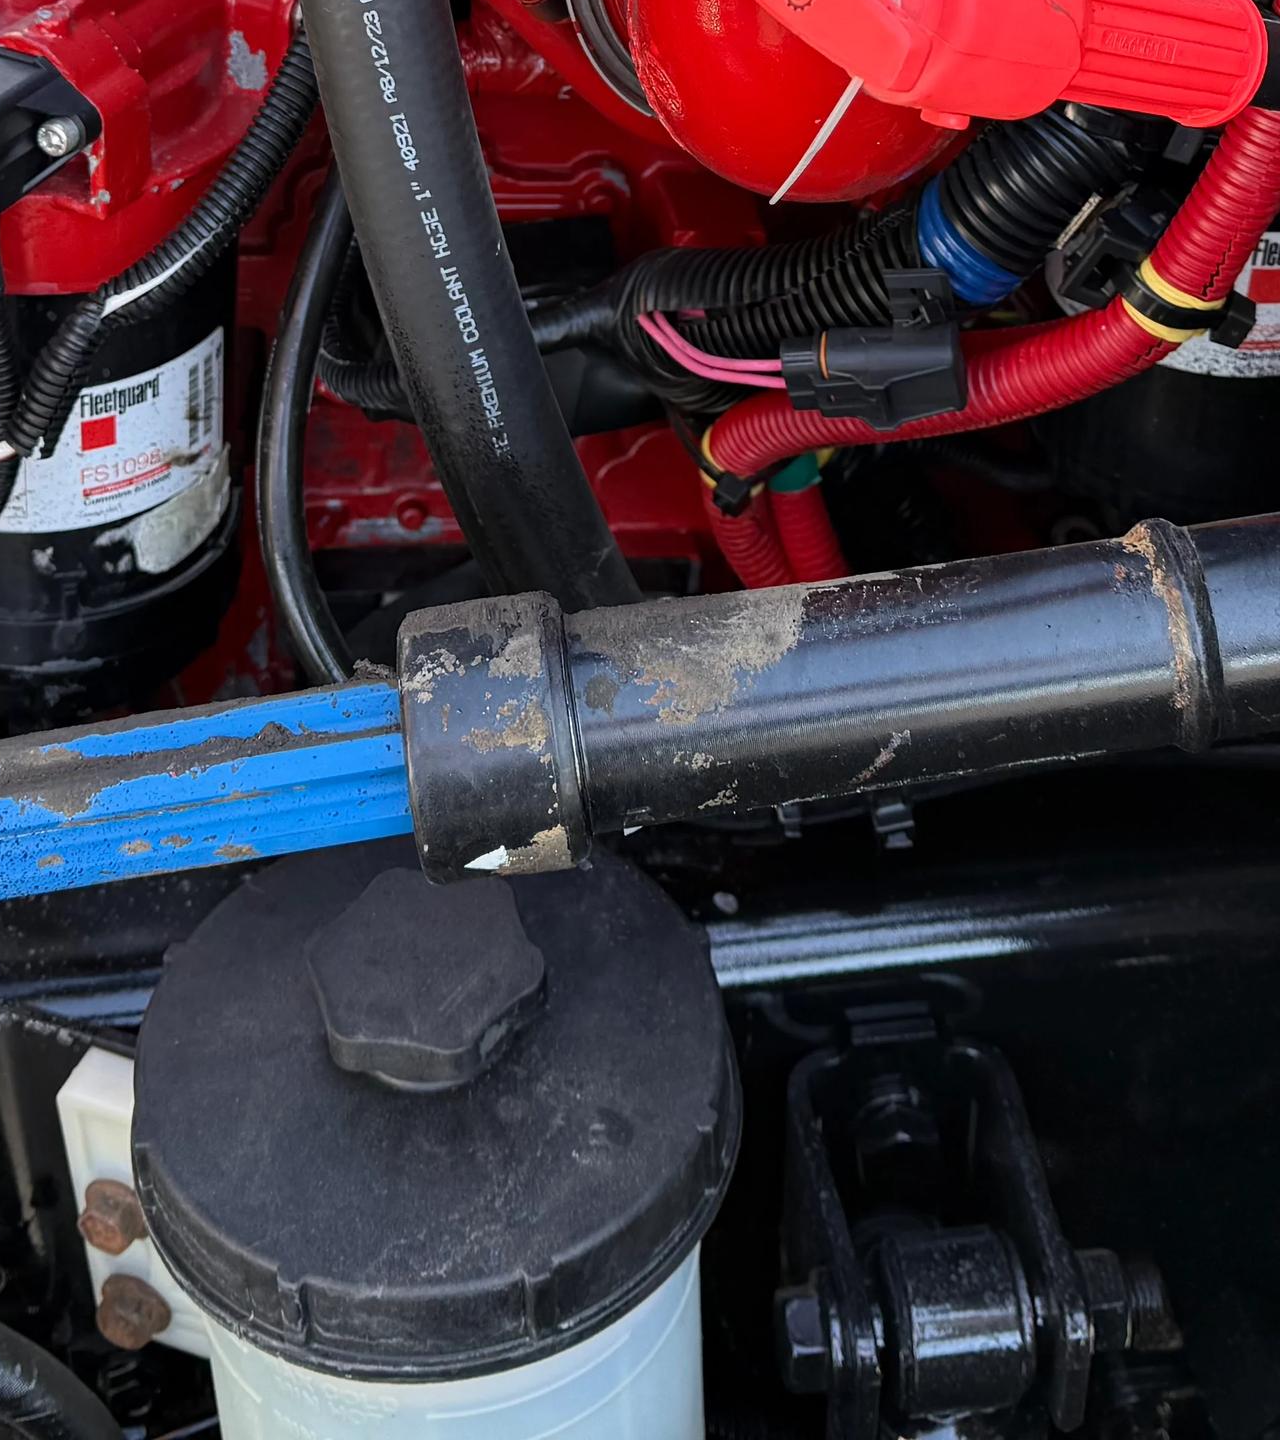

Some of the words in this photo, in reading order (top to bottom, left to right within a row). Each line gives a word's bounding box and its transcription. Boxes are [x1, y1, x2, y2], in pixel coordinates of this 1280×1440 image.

[389, 112, 420, 171] 40921
[421, 207, 451, 260] HOSE
[440, 266, 480, 344] COOLANT
[80, 374, 161, 417] Fleetguard
[468, 348, 504, 429] PREMIUM
